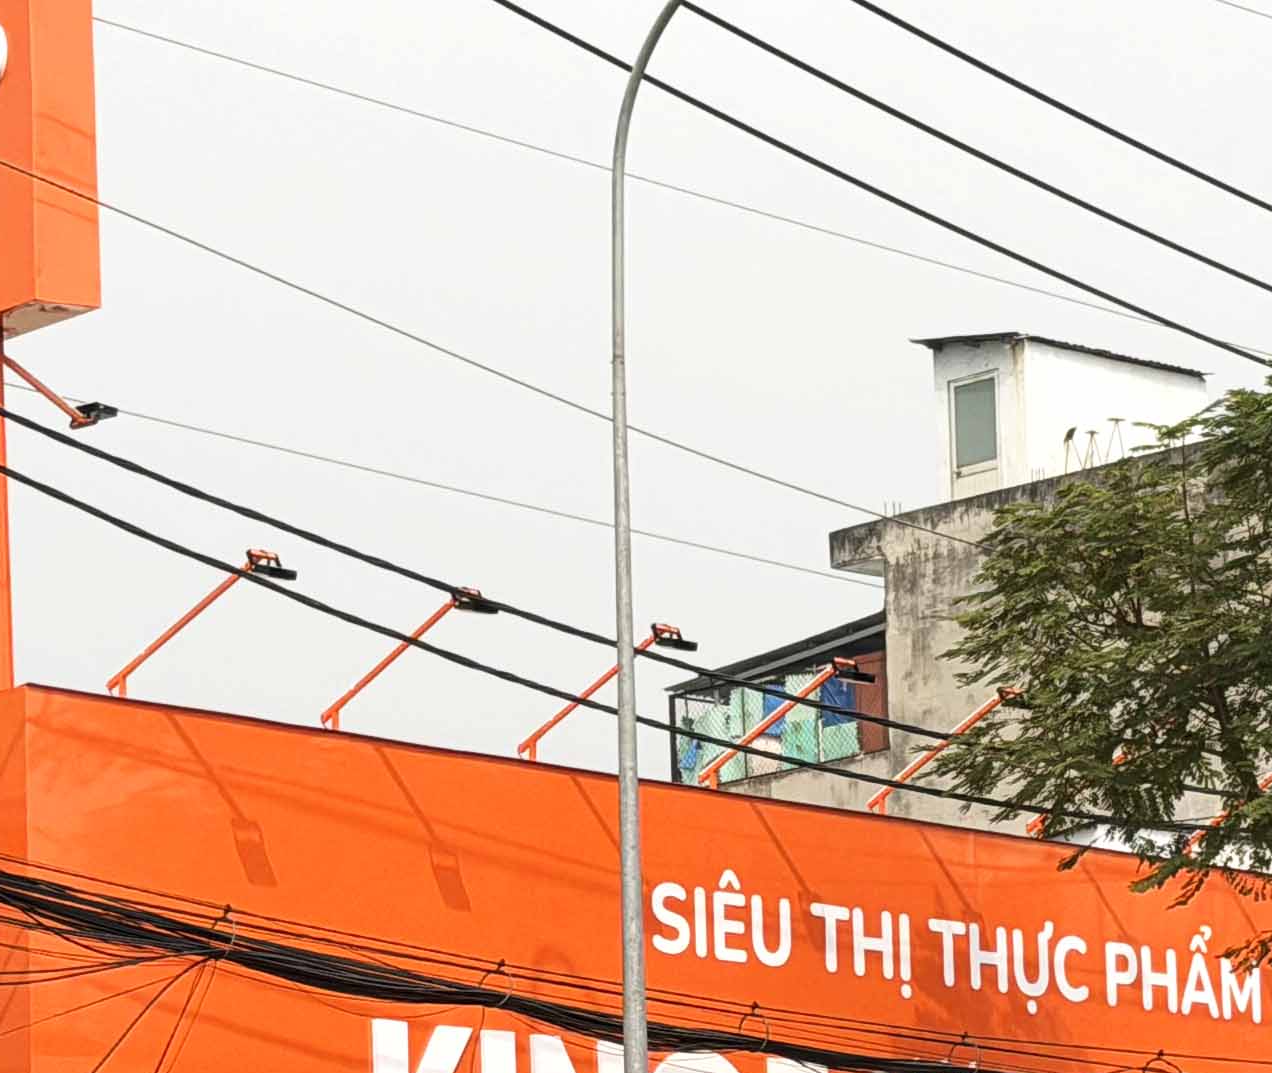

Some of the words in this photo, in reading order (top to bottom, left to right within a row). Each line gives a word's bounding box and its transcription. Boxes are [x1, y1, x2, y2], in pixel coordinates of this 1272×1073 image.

[652, 868, 792, 968] SIÊU
[810, 901, 915, 999] THỊ
[928, 916, 1091, 1016] THỰC
[1105, 922, 1264, 1026] PHẨM
